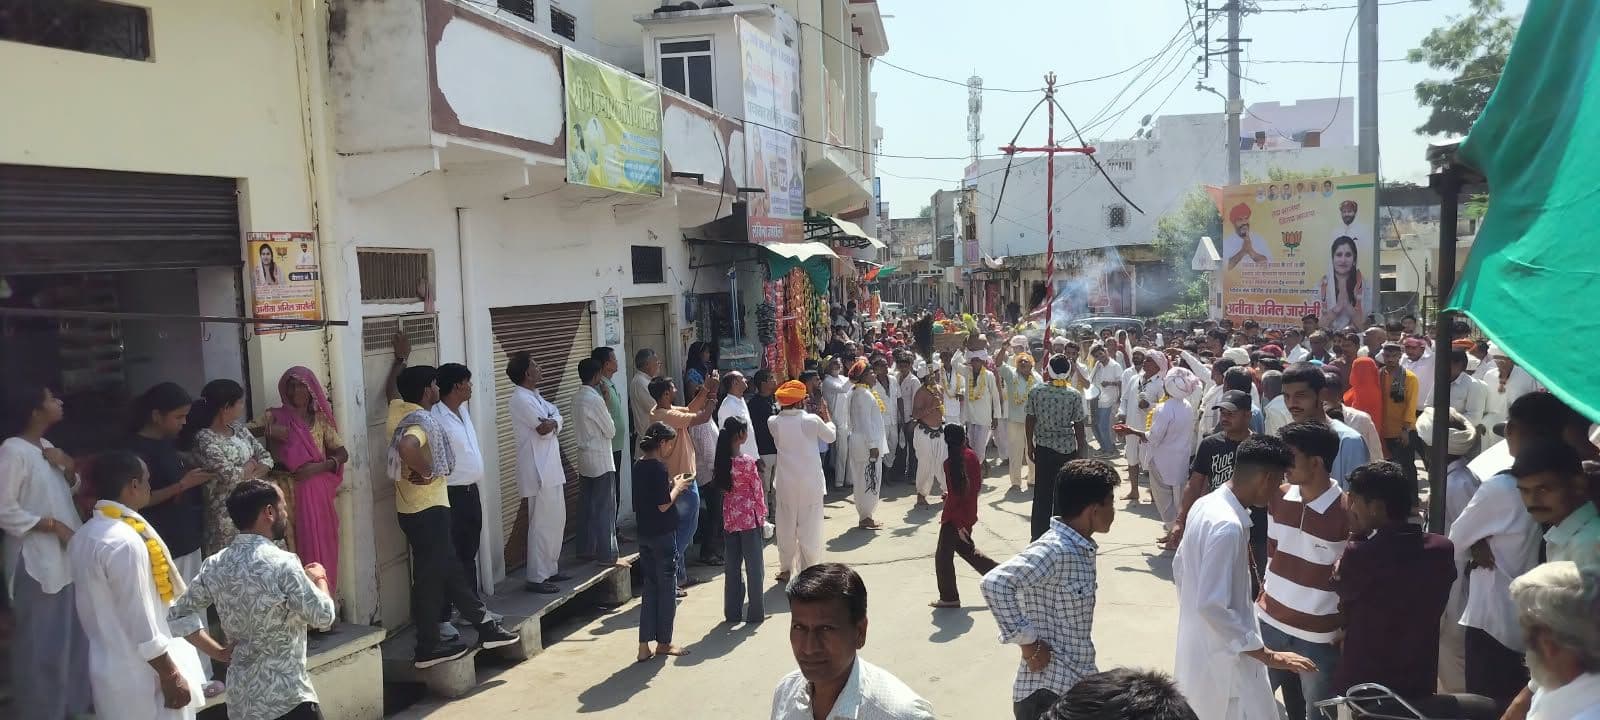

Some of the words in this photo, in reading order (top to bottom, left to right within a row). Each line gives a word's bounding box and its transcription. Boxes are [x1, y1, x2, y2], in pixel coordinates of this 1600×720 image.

[1227, 299, 1254, 315] अनीता
[1256, 300, 1284, 316] अनिल
[1286, 301, 1321, 318] जारोली
